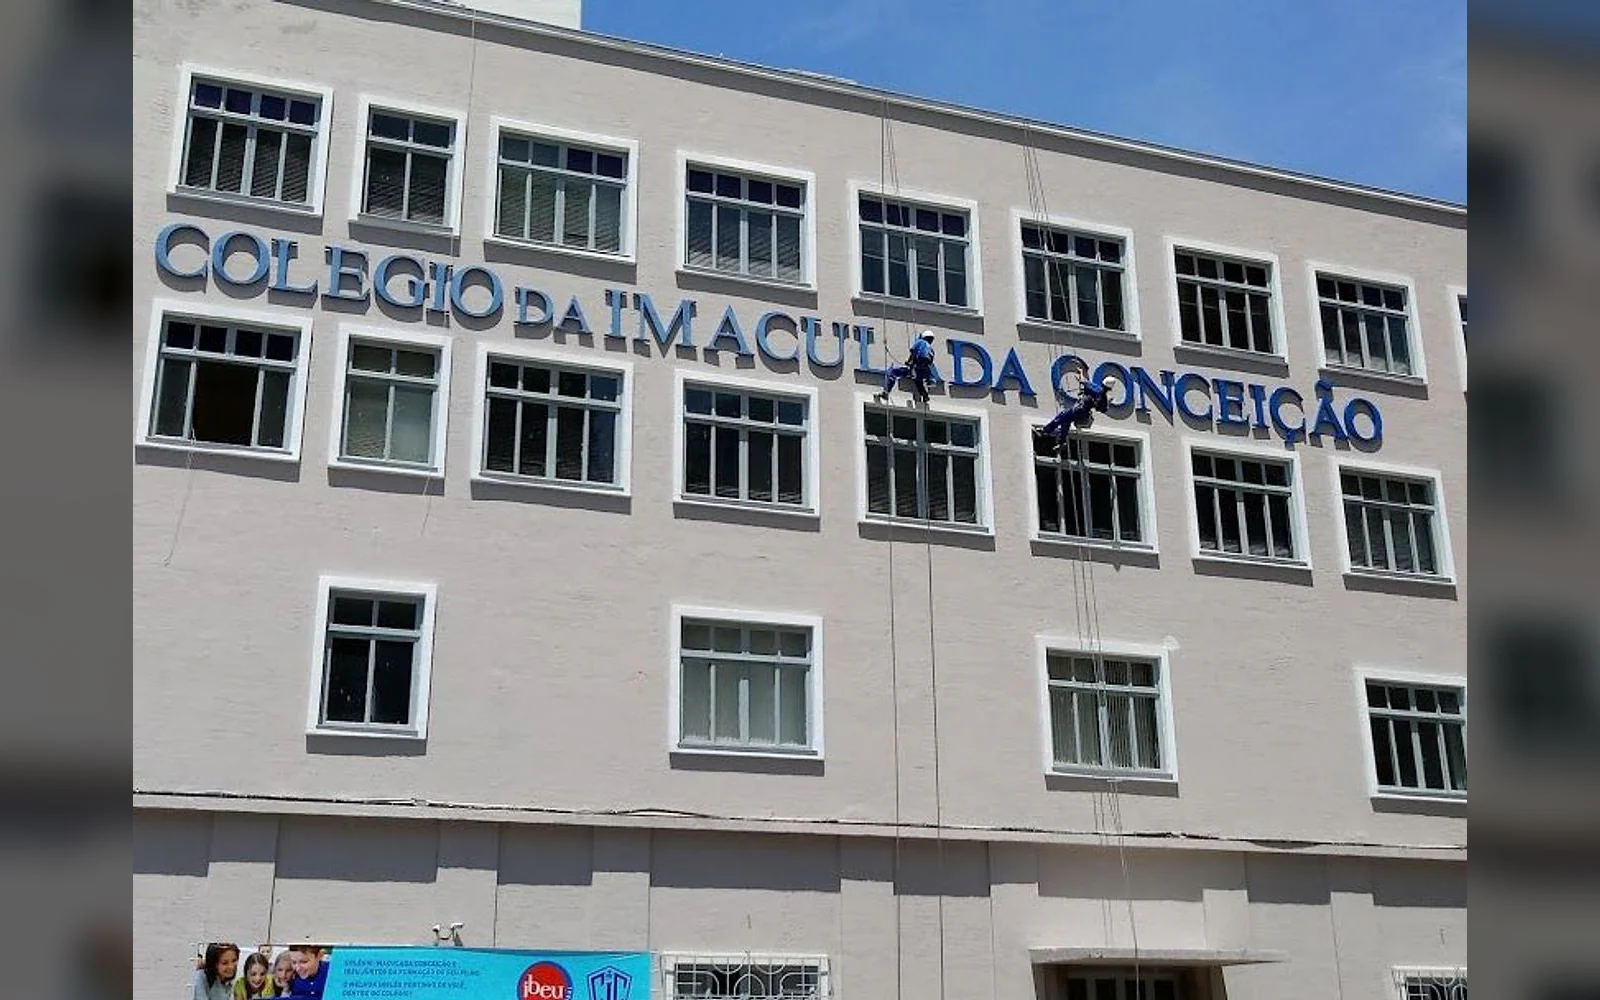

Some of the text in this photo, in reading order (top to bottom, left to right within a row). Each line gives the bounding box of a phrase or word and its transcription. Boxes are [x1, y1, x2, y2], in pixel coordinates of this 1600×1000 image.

[155, 223, 504, 318] COLEGIO
[515, 286, 592, 335] DA
[1051, 354, 1383, 446] CONCEIÇÃO
